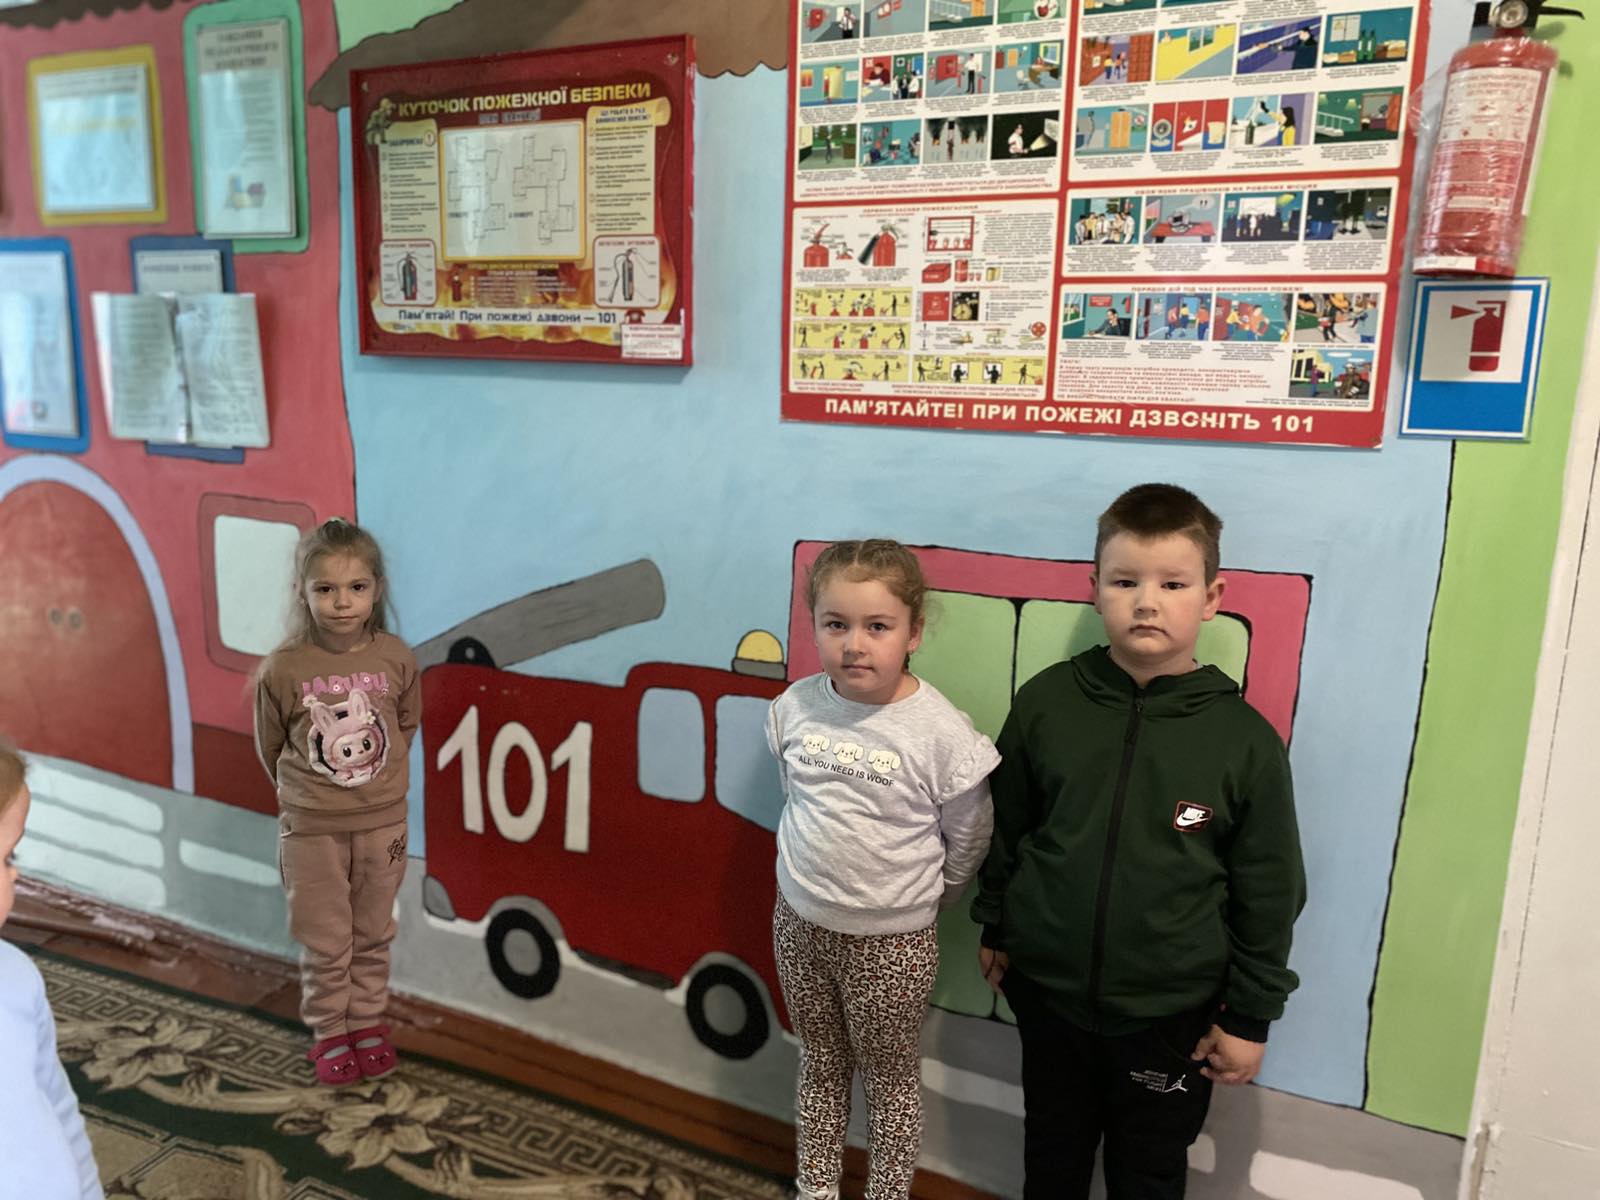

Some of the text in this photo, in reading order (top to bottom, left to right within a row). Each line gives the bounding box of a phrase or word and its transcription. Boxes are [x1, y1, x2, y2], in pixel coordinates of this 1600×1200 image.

[399, 82, 651, 117] КУТОЧОК ПОЖЕЖНОЇ БЕЗПЕКИ
[459, 312, 483, 323] При
[487, 311, 532, 322] пожежі
[598, 313, 617, 323] 101
[825, 399, 963, 419] ПАМ'ЯТАЙТЕ!
[972, 404, 1016, 420] ПРИ
[1025, 406, 1121, 424] ПОЖЕЖІ
[1271, 415, 1314, 432] 101
[437, 704, 593, 854] 101
[798, 755, 894, 787] ALL YOU NEED IS WOOF
